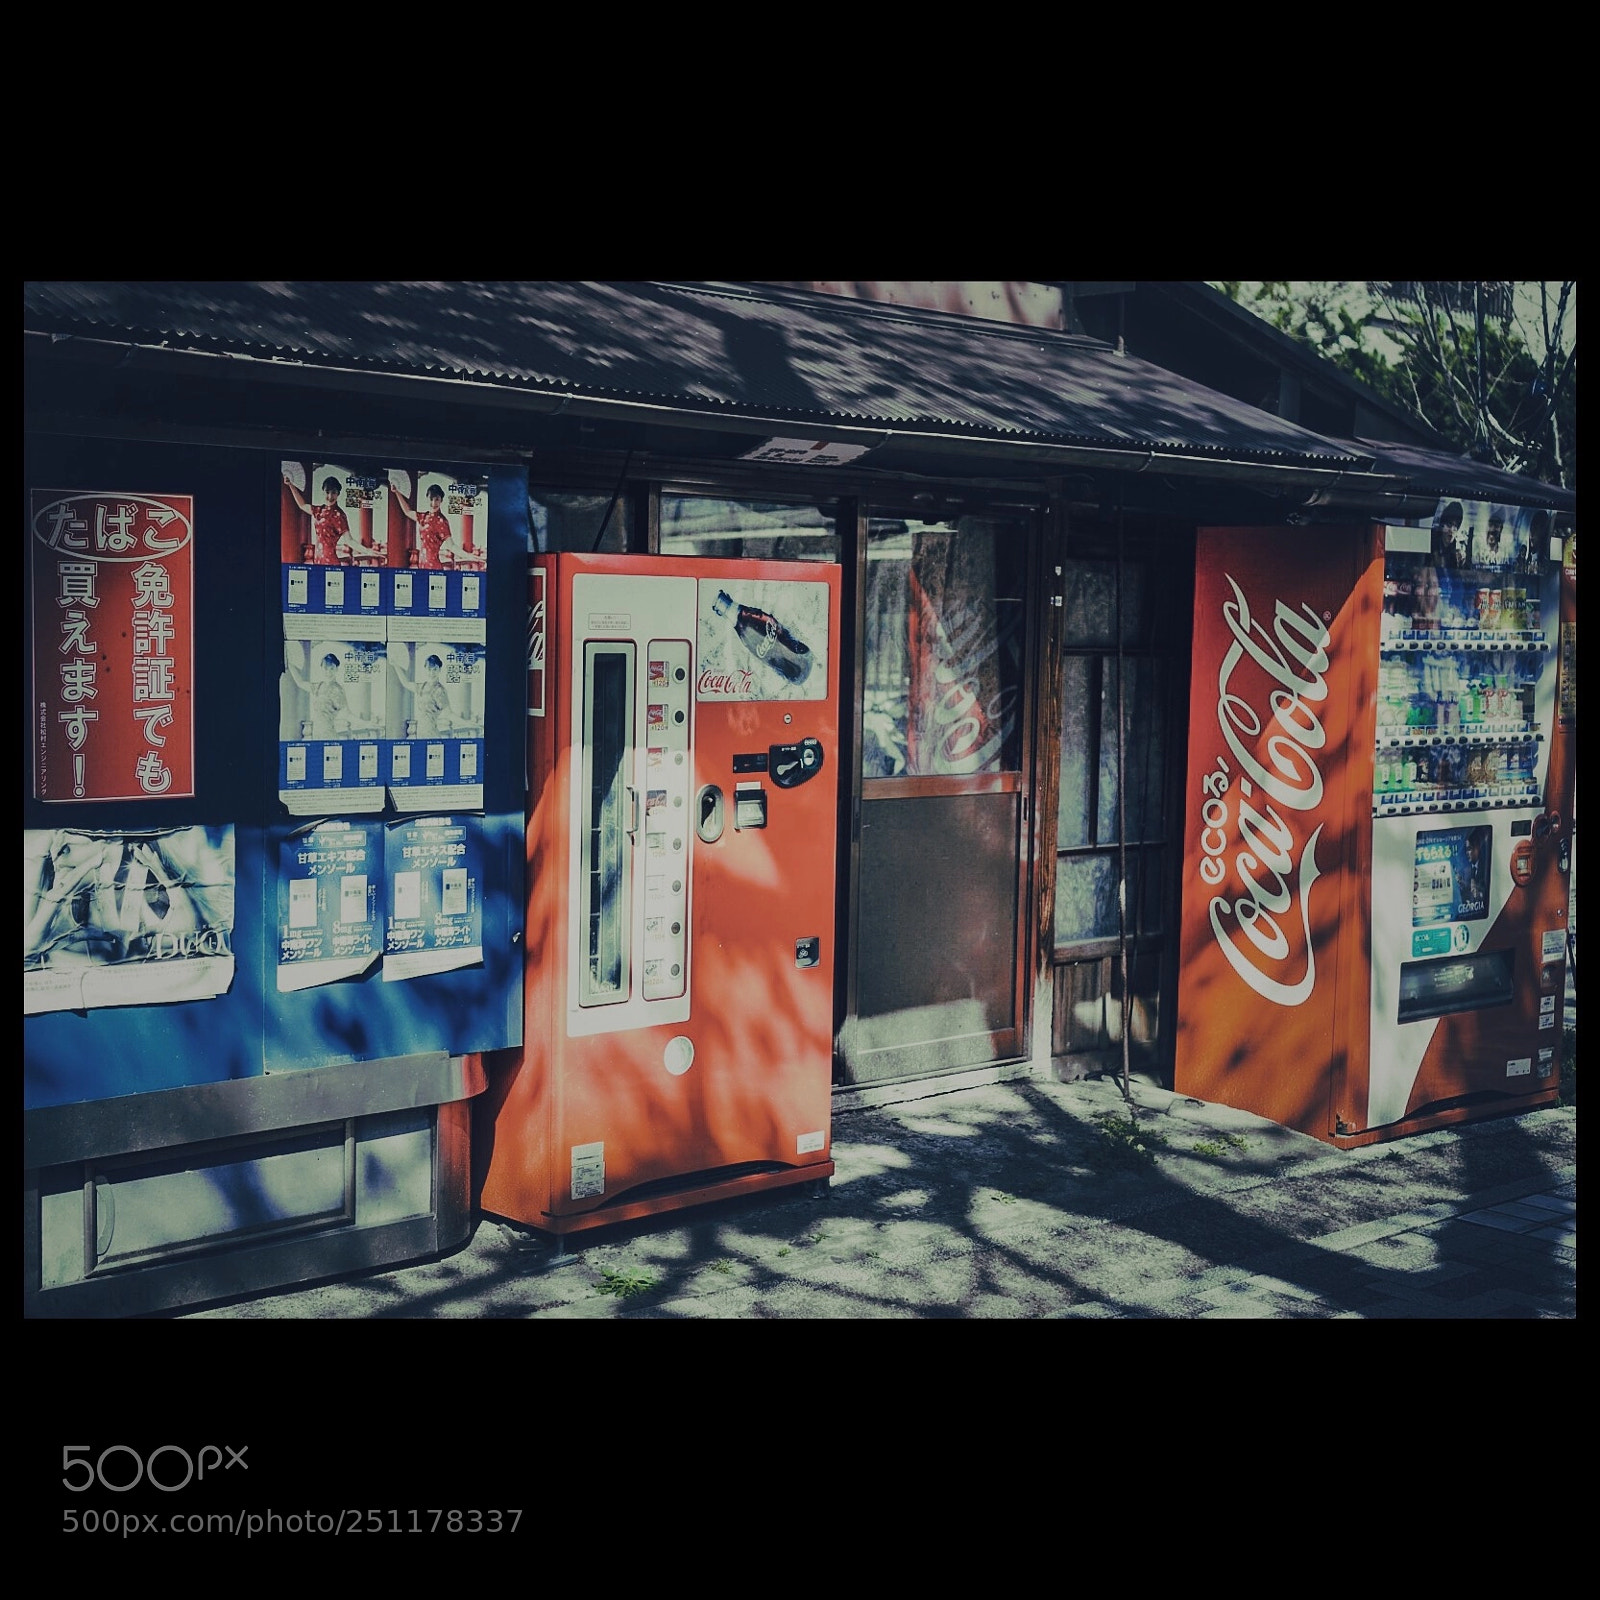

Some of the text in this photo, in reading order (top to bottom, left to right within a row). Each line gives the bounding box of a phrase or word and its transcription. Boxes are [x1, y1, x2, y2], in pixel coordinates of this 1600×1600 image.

[46, 501, 180, 552] たばこ
[130, 561, 175, 795] 免許証でも
[1209, 572, 1331, 1006] Coca-Cola
[307, 862, 356, 876] メンソール
[412, 857, 457, 868] メンソール
[1457, 900, 1485, 914] GEORGIA
